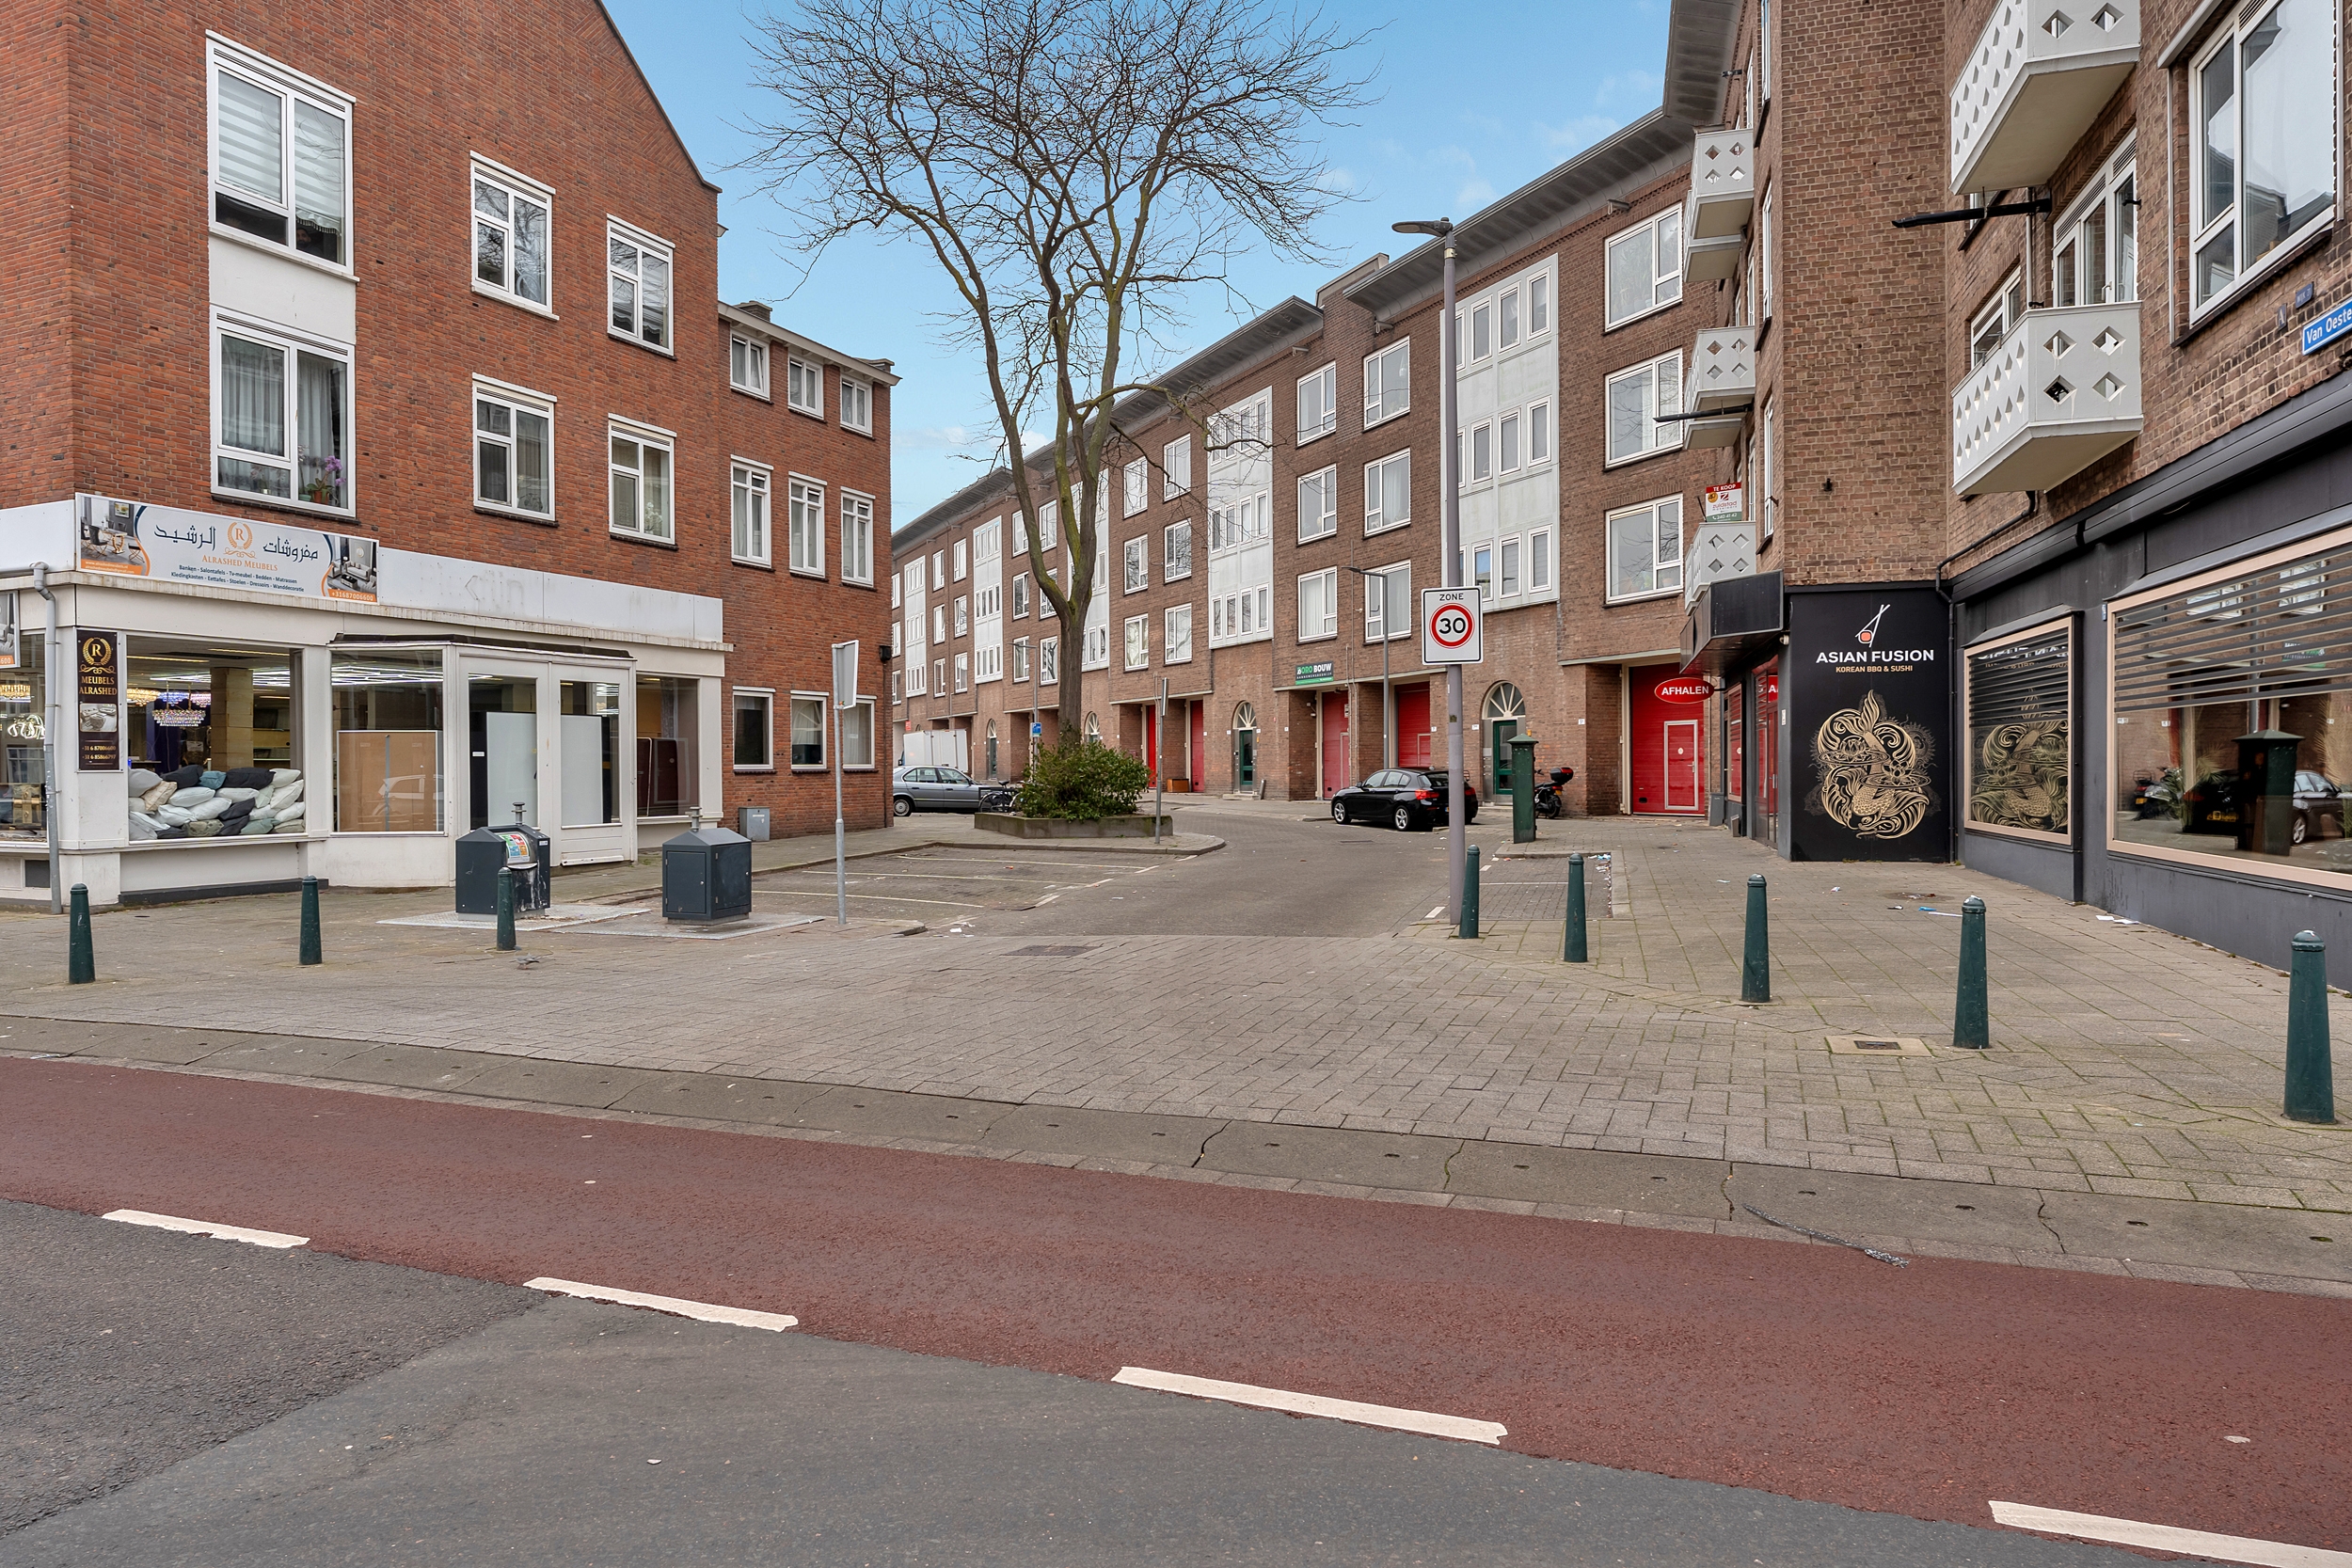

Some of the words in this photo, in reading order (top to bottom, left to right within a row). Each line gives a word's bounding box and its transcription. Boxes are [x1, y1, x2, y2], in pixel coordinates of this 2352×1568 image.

[2307, 326, 2323, 344] Van
[153, 525, 216, 551] الرشيد
[235, 528, 246, 542] R
[262, 535, 319, 562] مفروشات
[201, 554, 243, 567] ALRASHED
[245, 560, 278, 572] MEUBELS
[170, 571, 204, 580] Kledingkasten
[249, 580, 270, 589] Dressoirs
[273, 583, 305, 593] Wanddecoratie
[199, 566, 226, 576] Salontafels
[275, 576, 298, 584] Matrassen
[331, 591, 374, 602] +31687006600
[1439, 593, 1464, 601] ZONE
[1438, 617, 1467, 635] 30
[91, 643, 103, 657] R
[1816, 651, 1867, 664] ASIAN
[1871, 649, 1934, 662] FUSION
[1313, 662, 1332, 673] BOUW
[81, 675, 115, 685] MEUBELS
[79, 687, 118, 695] ALRASHED
[1661, 686, 1709, 696] AFHALEN
